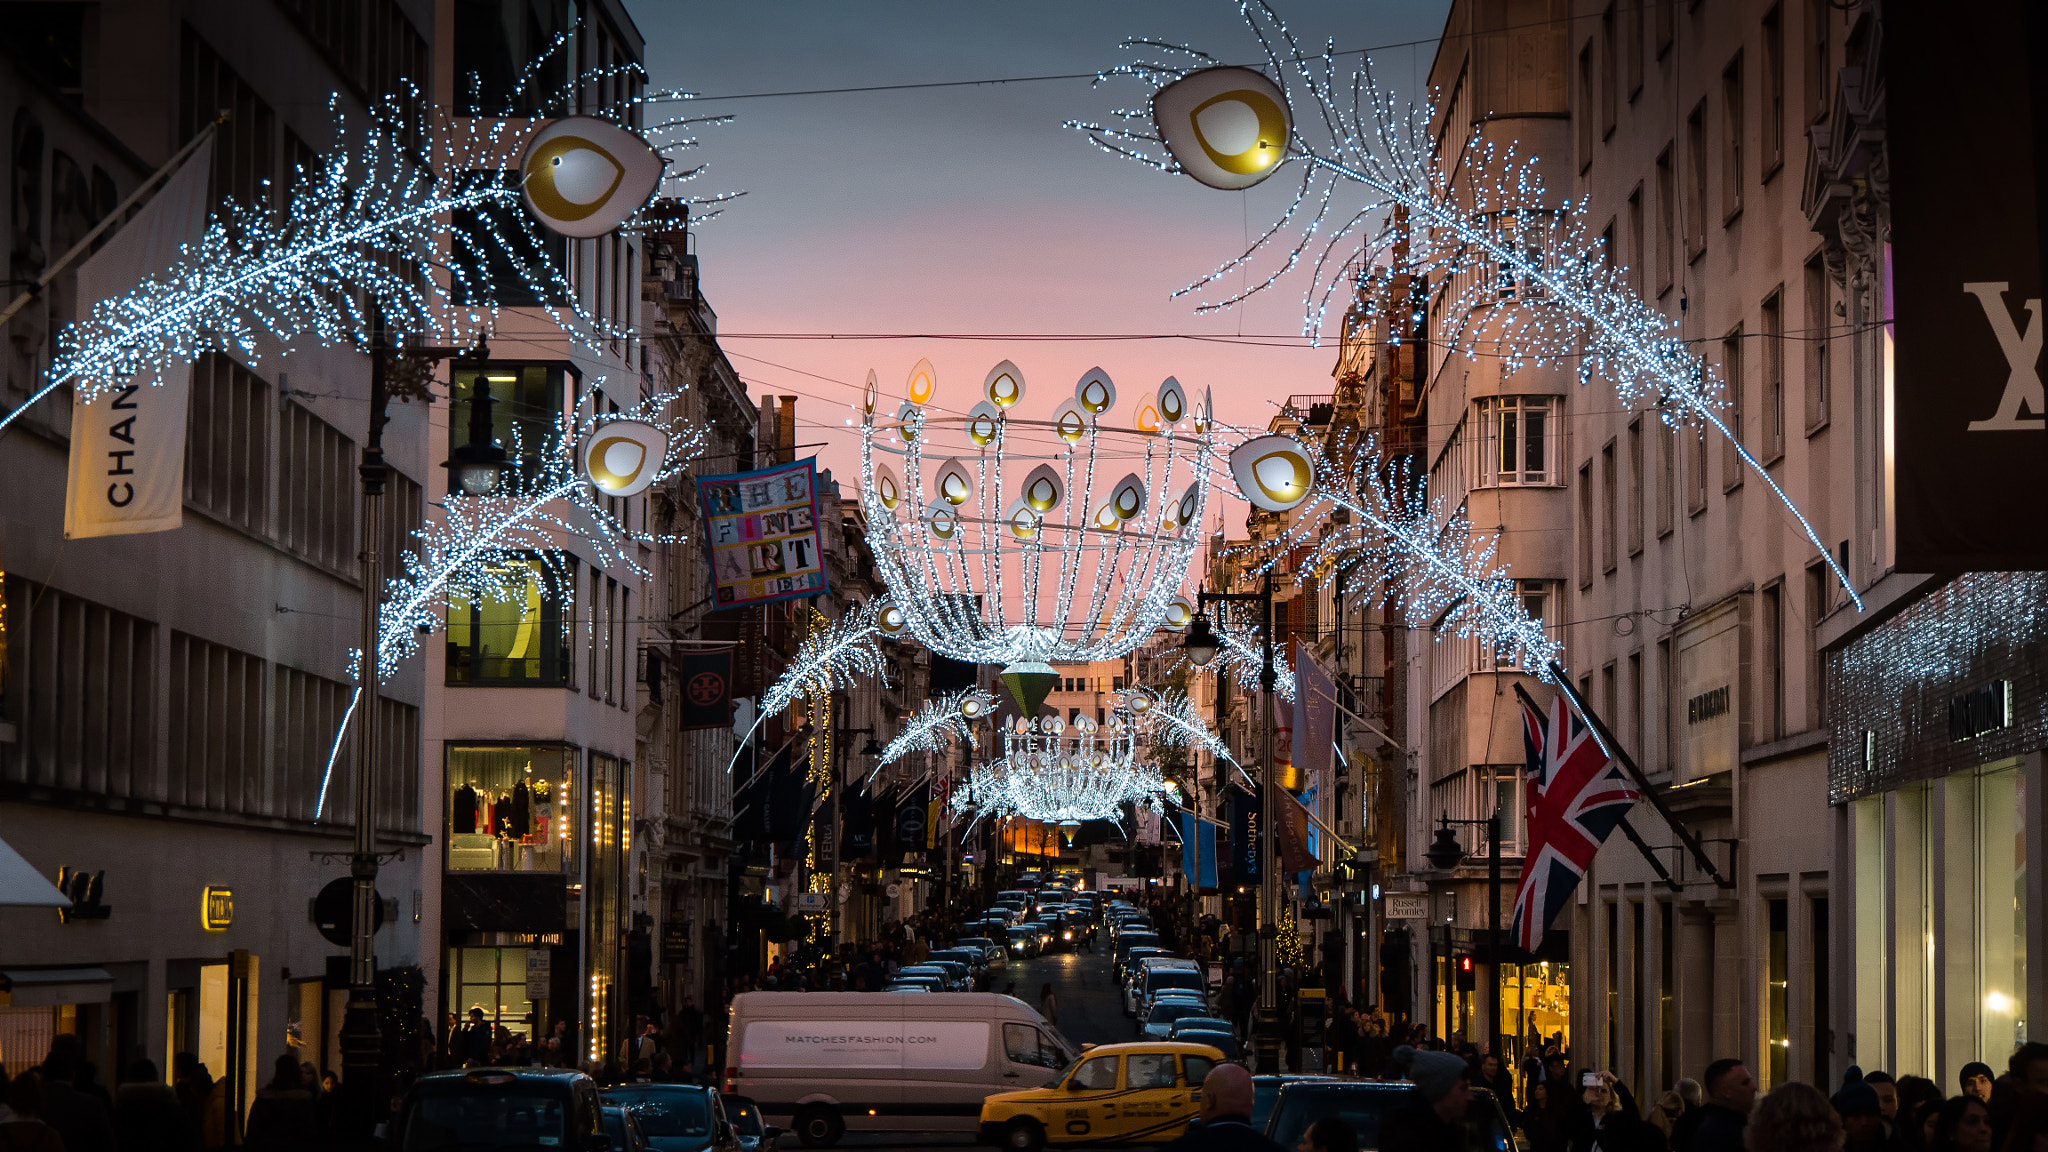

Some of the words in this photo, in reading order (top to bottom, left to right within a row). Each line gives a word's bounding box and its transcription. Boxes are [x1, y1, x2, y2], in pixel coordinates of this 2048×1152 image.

[107, 350, 139, 508] CHAN
[708, 472, 807, 512] THE
[718, 506, 814, 543] FINE
[722, 538, 811, 579] ART
[1688, 684, 1730, 724] BURBERRY
[821, 823, 833, 861] FENDI
[1246, 811, 1259, 874] Sotheby's
[1388, 907, 1426, 917] Bromley
[1392, 894, 1421, 908] Russell
[785, 1036, 937, 1045] MATCHESFASHION.COM
